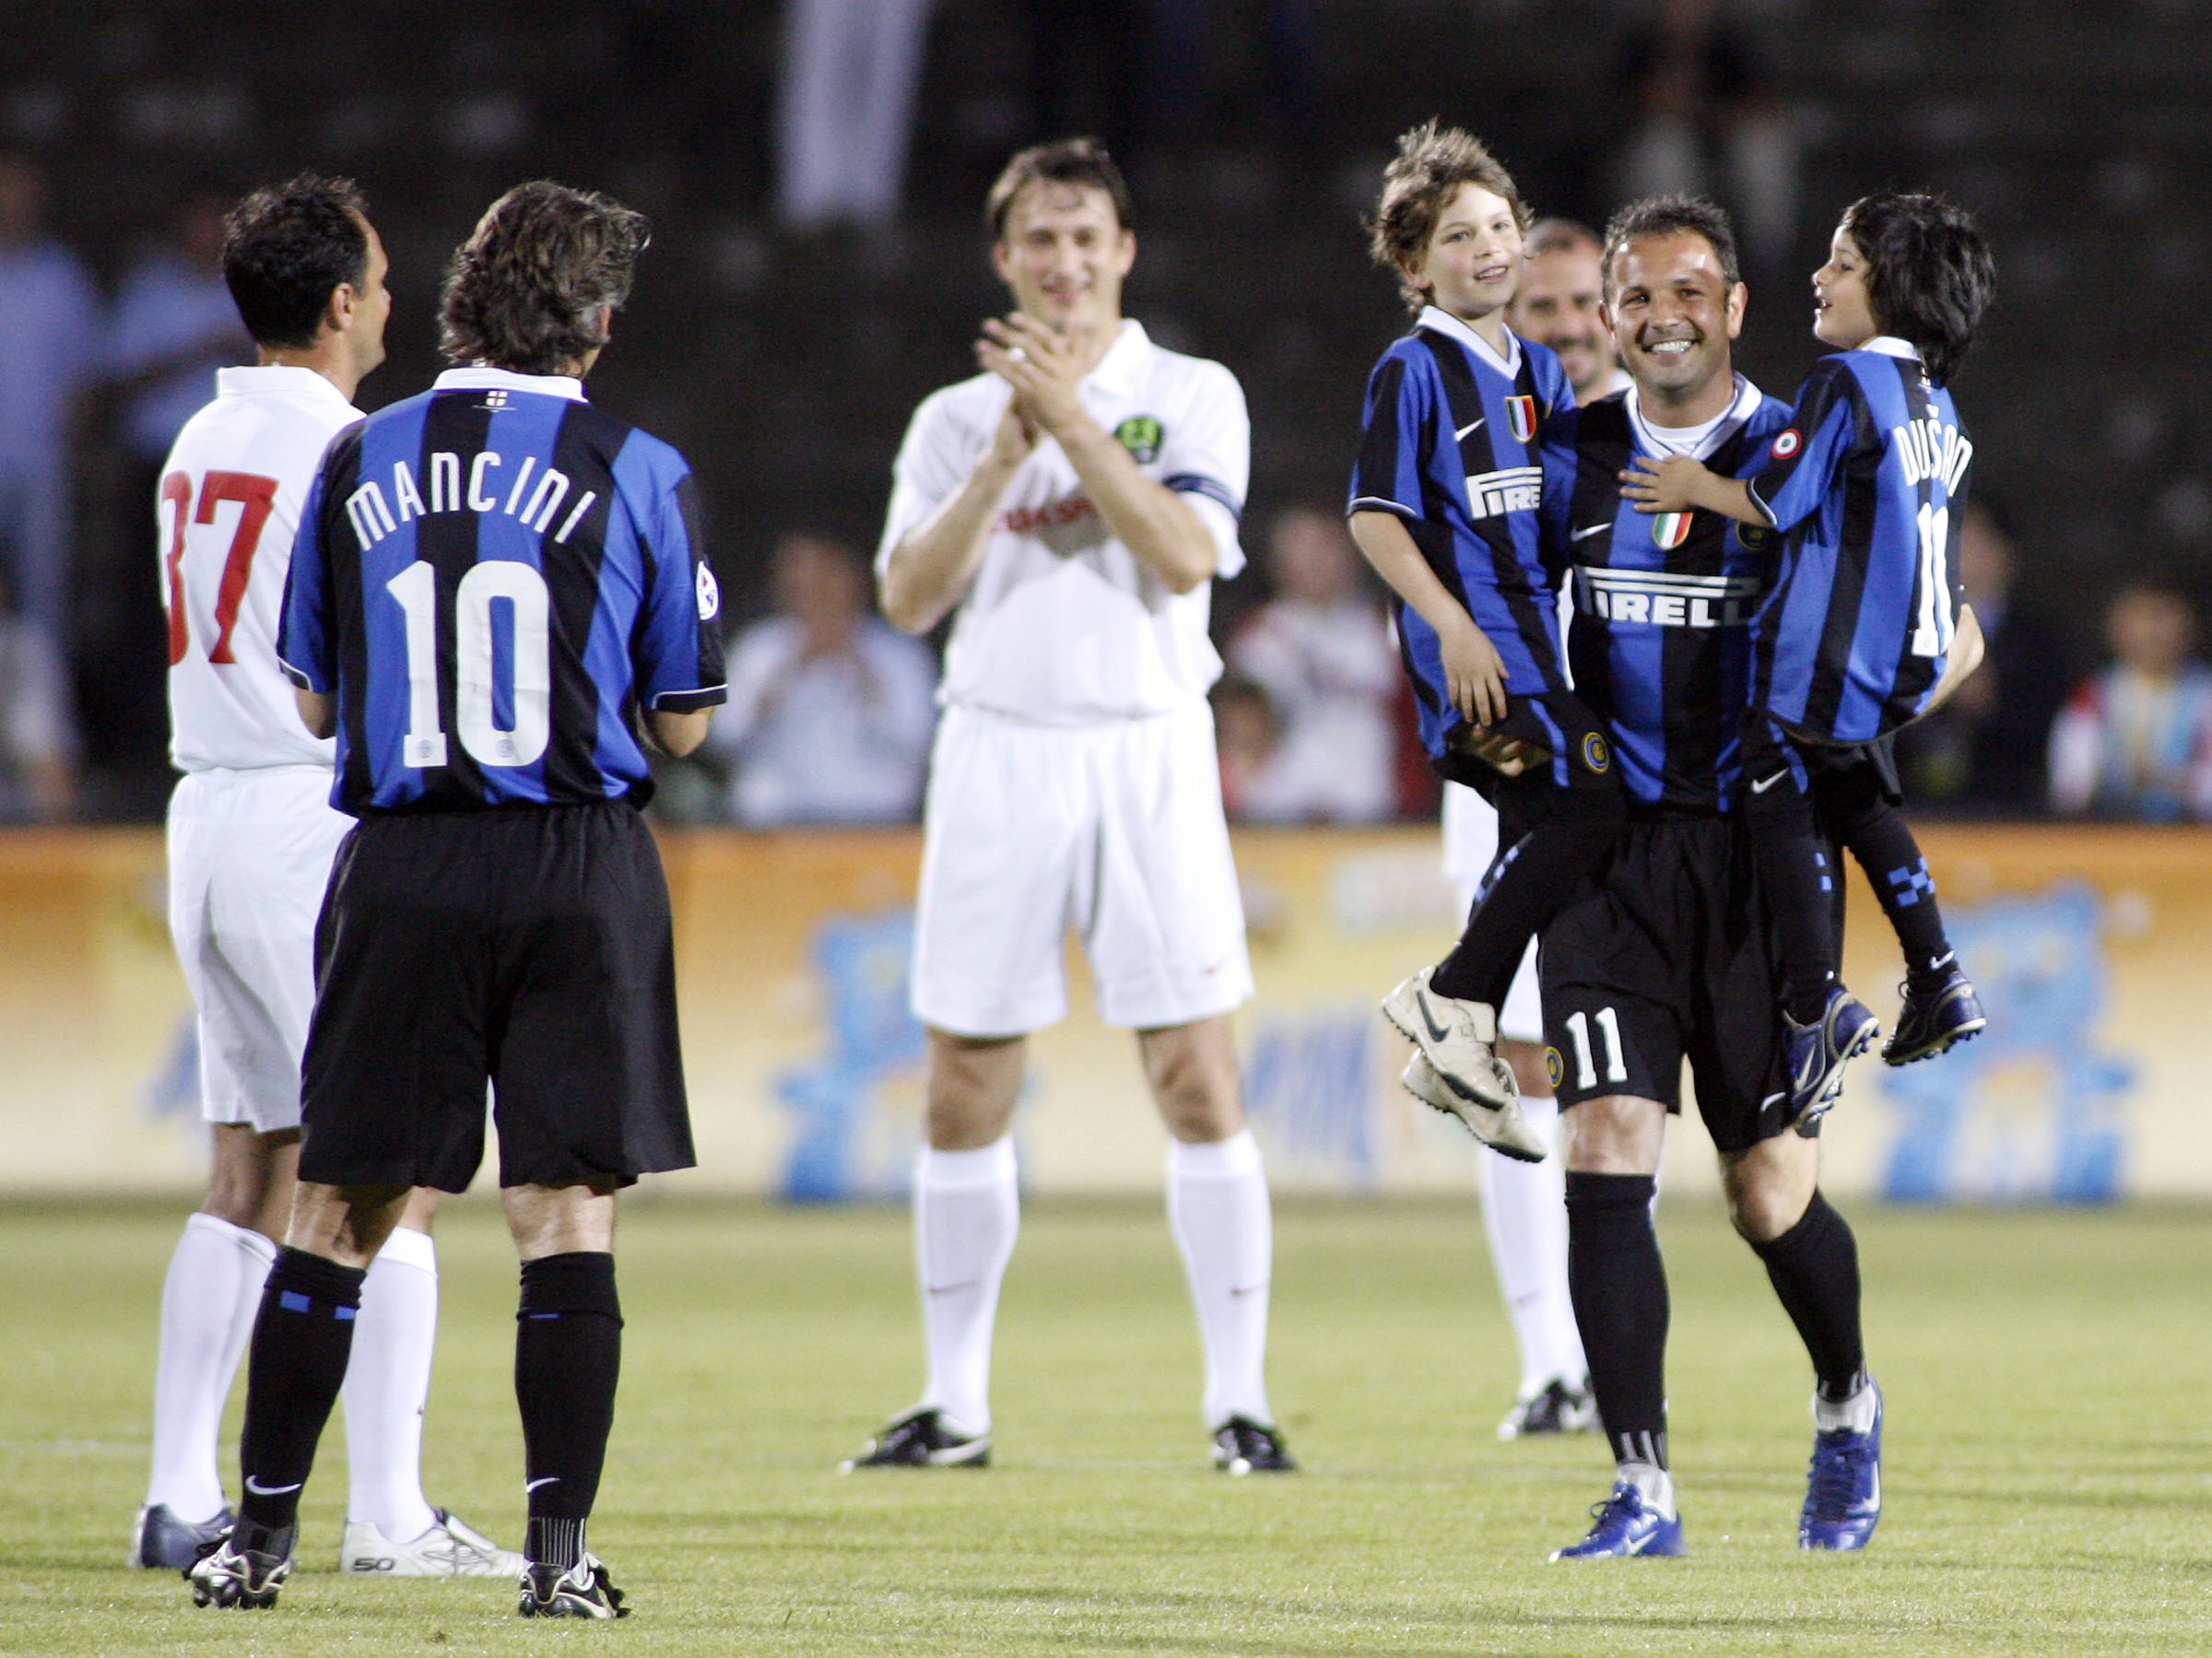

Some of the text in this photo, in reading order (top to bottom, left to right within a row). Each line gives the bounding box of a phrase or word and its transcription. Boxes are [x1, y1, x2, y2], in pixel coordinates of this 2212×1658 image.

[346, 451, 596, 551] MANCINI
[1912, 501, 1955, 657] 11
[385, 559, 550, 768] 10
[1565, 1005, 1629, 1090] 11
[353, 1558, 395, 1571] 50
